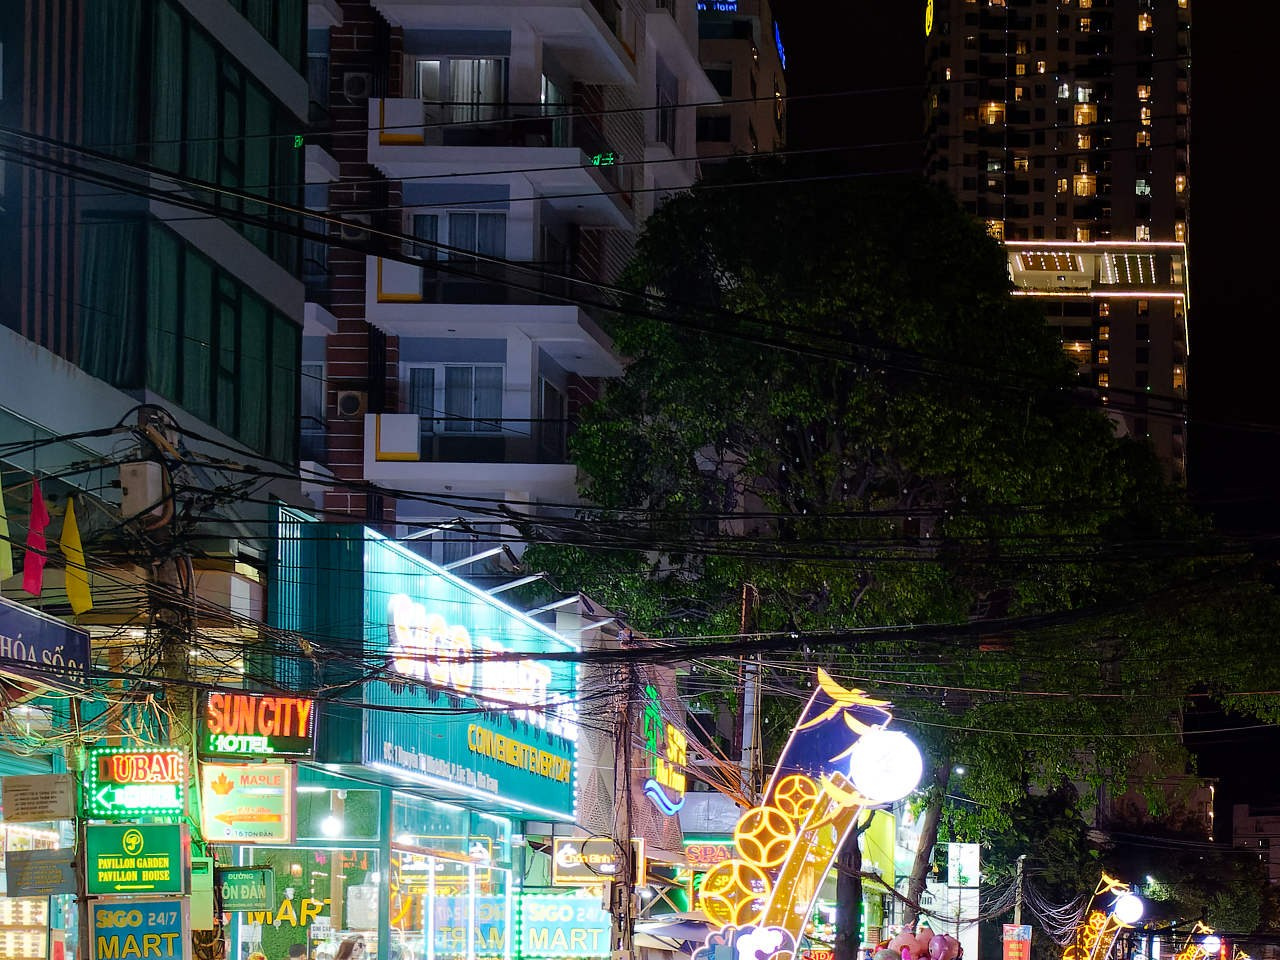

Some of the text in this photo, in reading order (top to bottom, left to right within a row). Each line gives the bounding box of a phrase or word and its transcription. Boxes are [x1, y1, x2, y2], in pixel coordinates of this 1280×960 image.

[42, 645, 65, 678] SỐ
[208, 695, 312, 738] SUN CITY
[209, 734, 274, 753] HOTEL
[240, 774, 282, 786] MAPLE
[98, 857, 170, 869] PAVILLON GARDEN
[685, 845, 730, 863] SPA
[98, 870, 170, 882] PAVILLON HOUSE
[221, 881, 239, 900] ÔN
[96, 909, 178, 929] SIGO 24/7
[529, 903, 574, 923] SIGO
[97, 933, 180, 960] MART
[529, 927, 605, 951] MART
